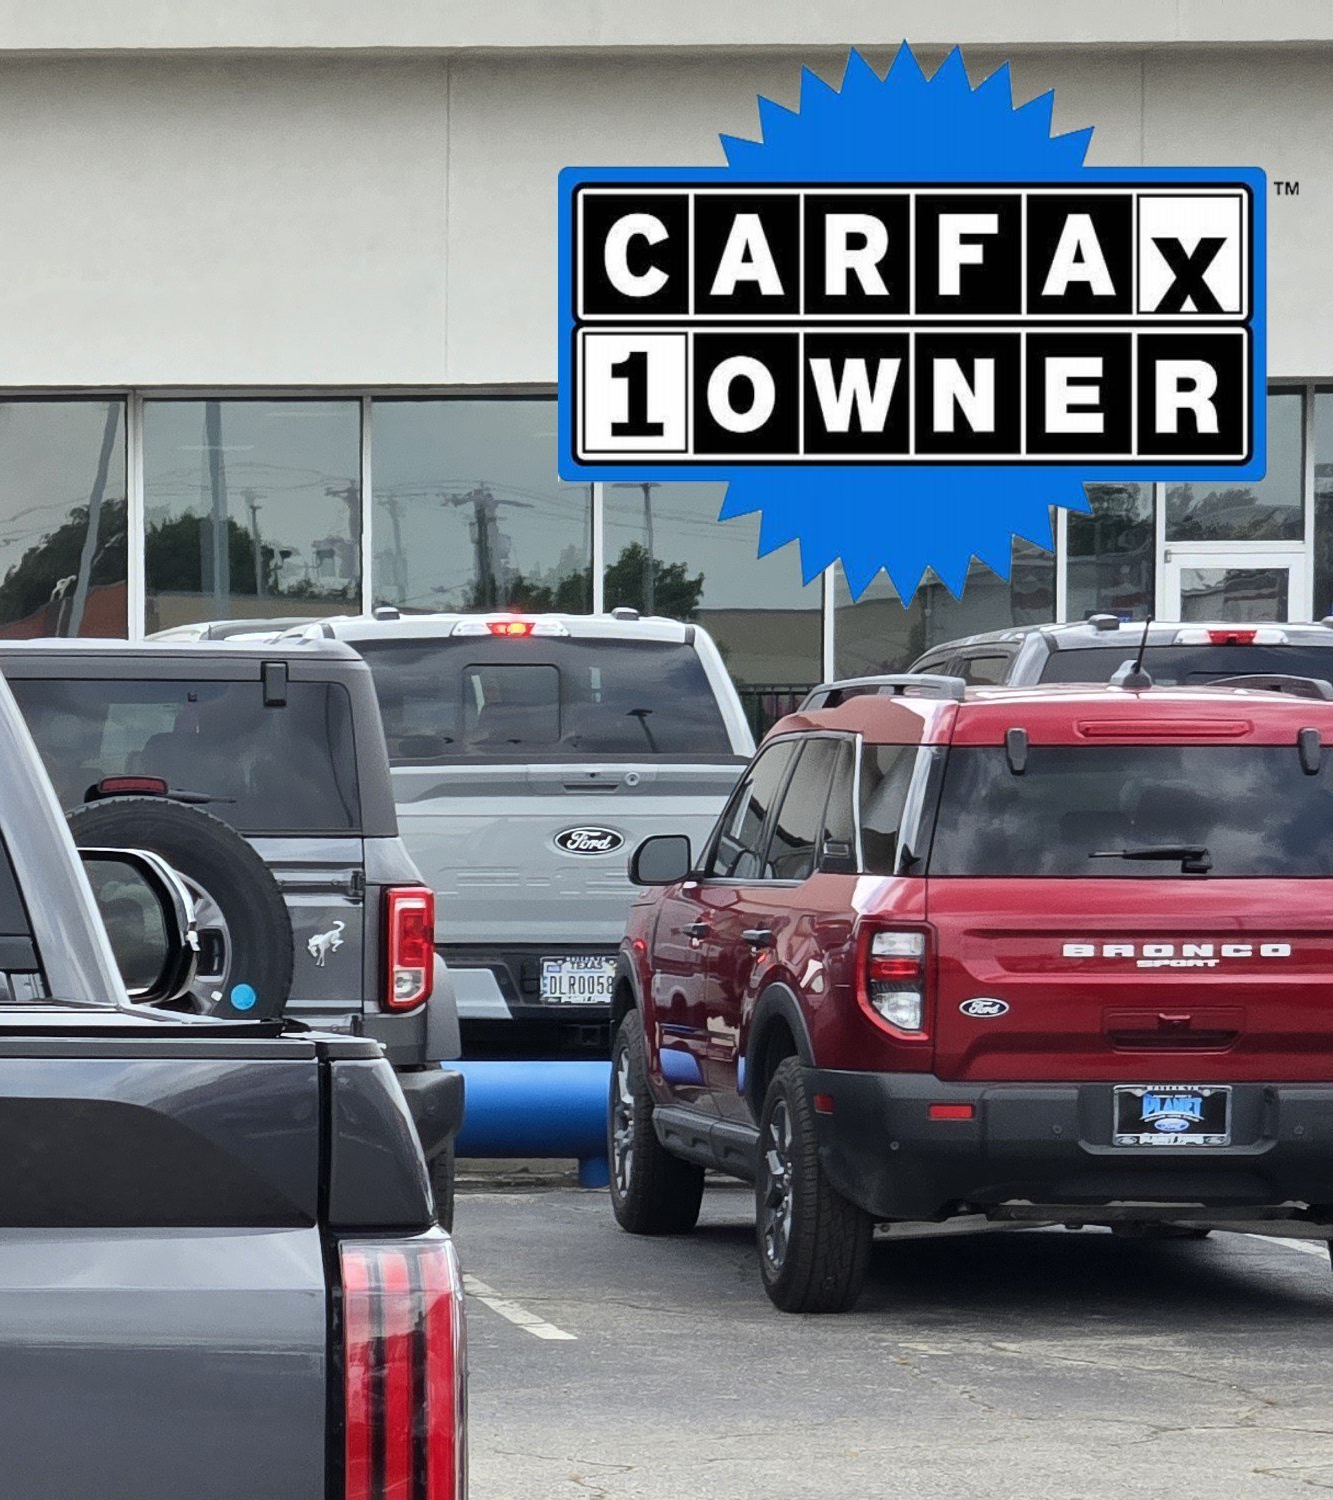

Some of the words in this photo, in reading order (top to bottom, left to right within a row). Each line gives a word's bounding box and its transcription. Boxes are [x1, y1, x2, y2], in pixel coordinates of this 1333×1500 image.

[566, 830, 613, 850] Ford
[1062, 943, 1291, 958] BRONCO
[1136, 959, 1220, 968] SPORT
